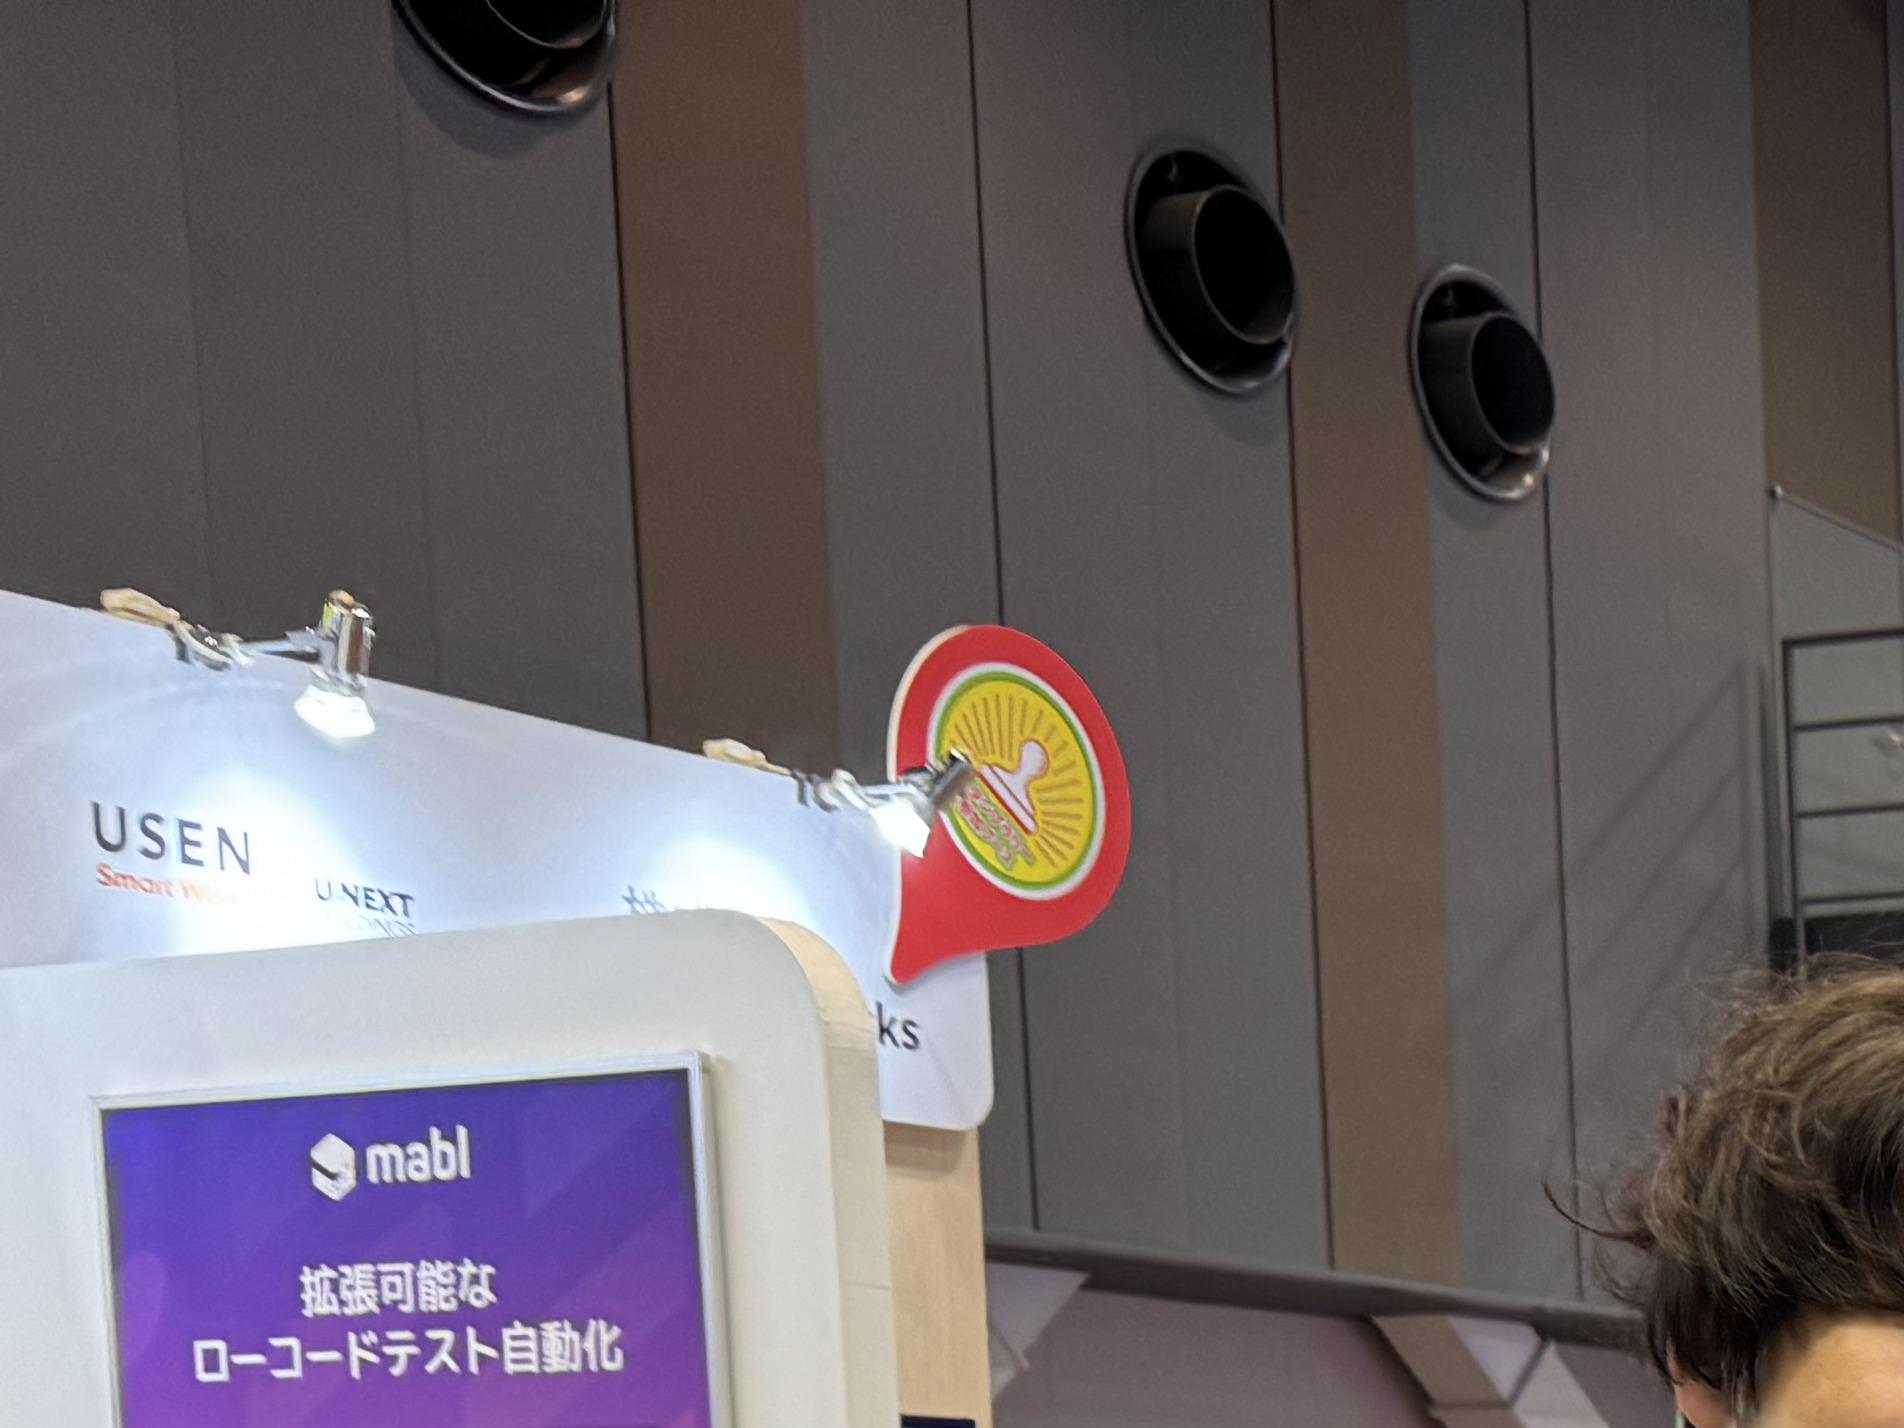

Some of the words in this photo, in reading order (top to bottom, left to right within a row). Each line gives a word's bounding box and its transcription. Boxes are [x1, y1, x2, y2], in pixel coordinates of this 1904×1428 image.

[91, 800, 251, 876] USEN
[876, 1001, 921, 1051] ks
[366, 1123, 472, 1185] mabl
[298, 1258, 500, 1319] 拡張可能な
[192, 1318, 625, 1384] ローコードテスト自動化
